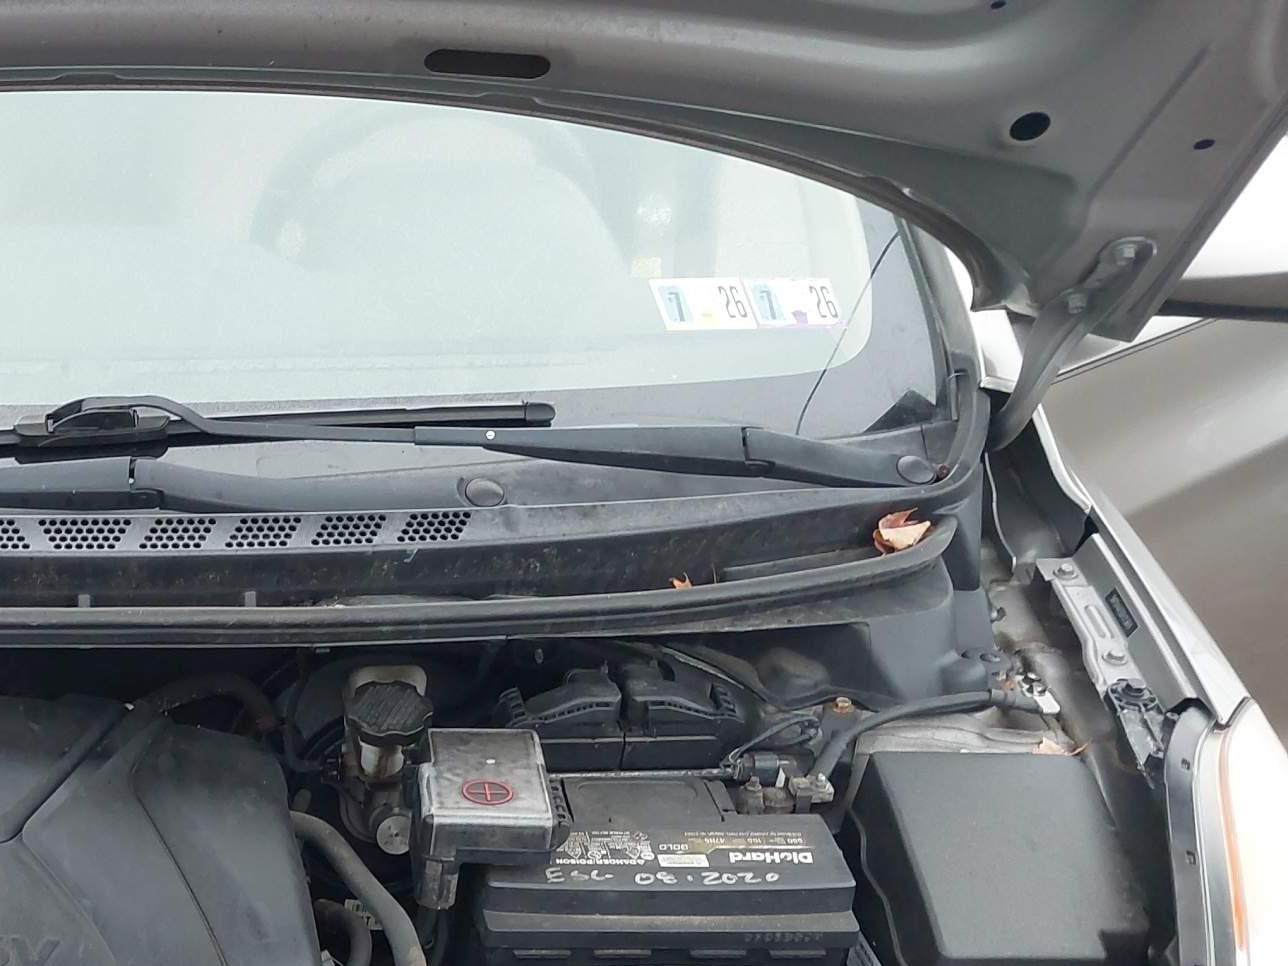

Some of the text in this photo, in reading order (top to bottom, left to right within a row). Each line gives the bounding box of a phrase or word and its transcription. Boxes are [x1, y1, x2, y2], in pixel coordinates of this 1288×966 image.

[717, 286, 748, 319] 26
[809, 286, 839, 319] 26
[658, 843, 689, 851] GOLD
